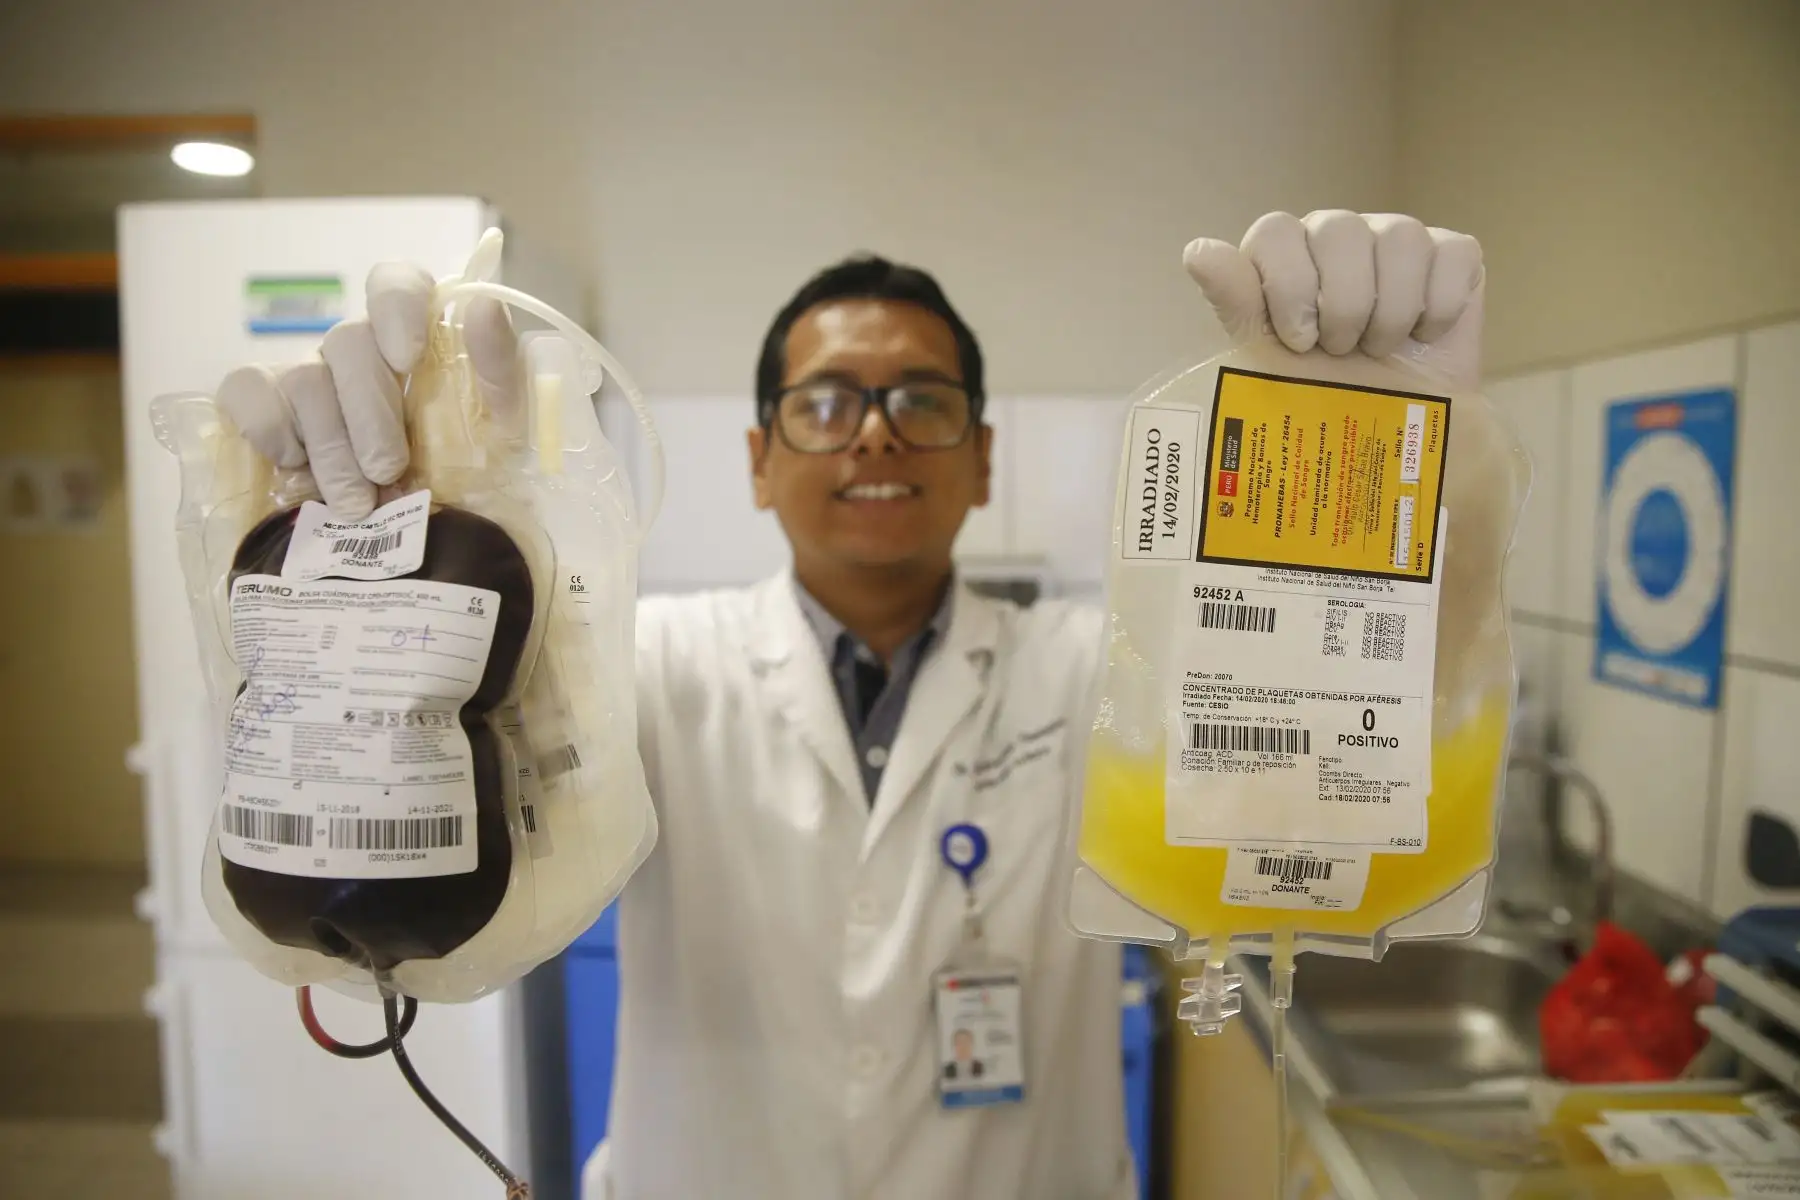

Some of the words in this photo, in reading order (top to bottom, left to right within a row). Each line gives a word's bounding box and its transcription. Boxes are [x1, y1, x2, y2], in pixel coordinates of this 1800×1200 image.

[1251, 428, 1258, 437] de
[1429, 410, 1438, 452] Plaquetas
[1294, 428, 1303, 458] Calidad
[1405, 424, 1419, 472] 326938
[1230, 460, 1236, 468] de
[1249, 440, 1257, 475] Nacional
[1293, 460, 1300, 469] de
[1316, 456, 1323, 466] de
[1252, 472, 1264, 524] Hemoterapia
[1259, 423, 1266, 432] de
[1264, 460, 1272, 488] Sangre
[1301, 460, 1309, 487] Sangre
[1323, 451, 1332, 491] normativa
[1338, 471, 1344, 480] de
[1139, 428, 1160, 552] IRRADIADO
[1162, 442, 1180, 539] 14/02/2020
[1291, 472, 1300, 506] Nacional
[1300, 489, 1306, 499] de
[1313, 468, 1322, 505] tamizada
[1244, 478, 1254, 517] Programa
[1275, 478, 1286, 538] PRONAHEBAS
[1310, 508, 1319, 536] Unidad
[341, 559, 384, 568] DONANTE
[236, 584, 292, 597] TERUMO
[1193, 586, 1230, 600] 92452
[1234, 590, 1244, 601] A
[1187, 672, 1213, 680] PreDon:
[1182, 684, 1244, 696] CONCENTRADO
[1246, 688, 1256, 696] DE
[1258, 689, 1304, 699] PLAQUETAS
[1305, 692, 1348, 702] OBTENIDAS
[1350, 695, 1365, 703] POR
[1367, 694, 1401, 705] AFÉRESIS
[1236, 695, 1268, 704] 14/02/2020
[1338, 734, 1398, 749] POSITIVO
[1336, 785, 1371, 794] 13/02/2020
[1272, 884, 1310, 894] DONANTE
[1280, 876, 1304, 885] 92452
